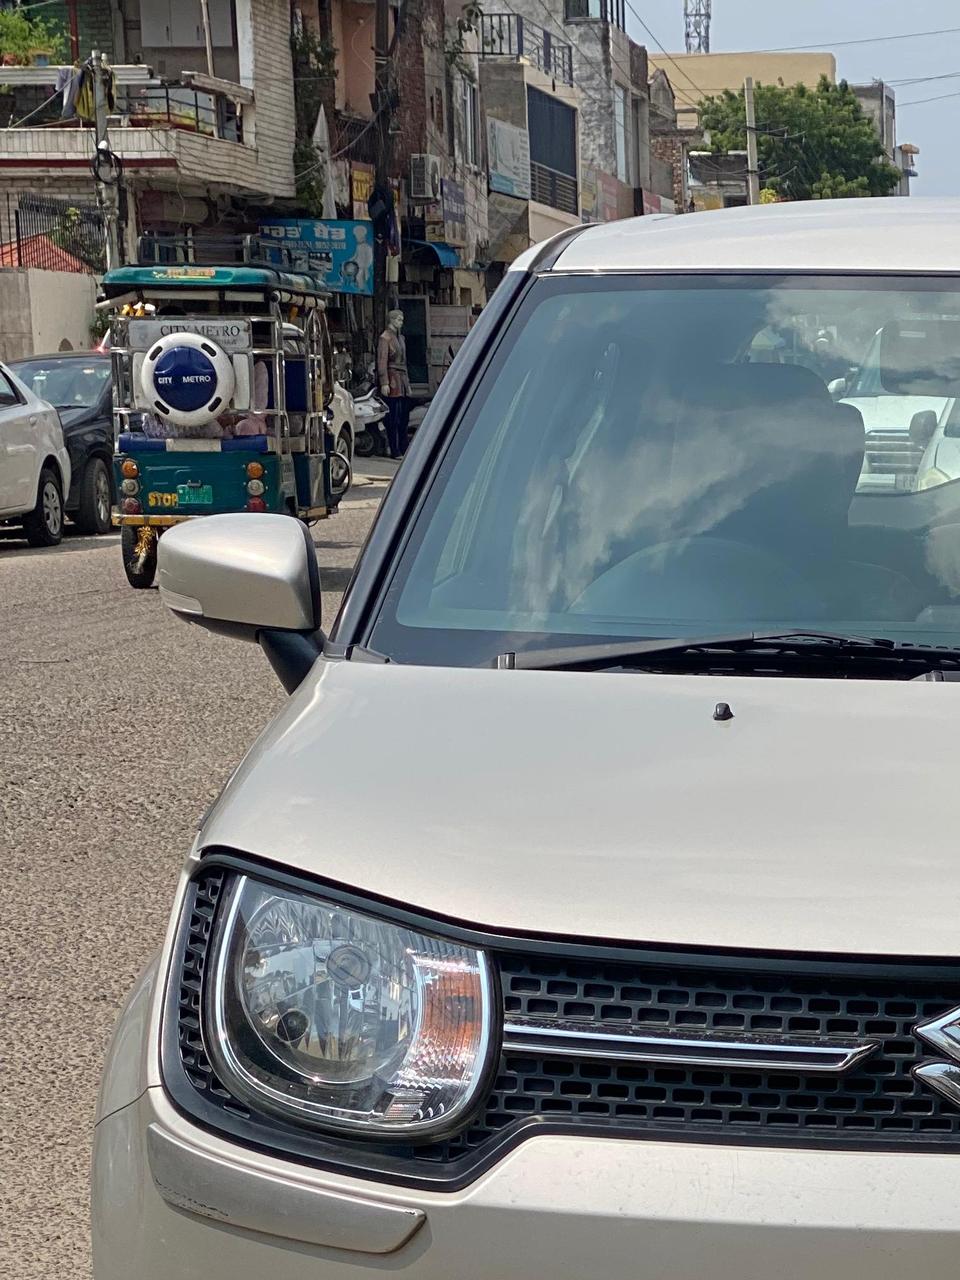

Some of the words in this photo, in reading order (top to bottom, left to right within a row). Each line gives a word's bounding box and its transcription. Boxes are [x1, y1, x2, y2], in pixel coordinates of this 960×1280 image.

[160, 326, 191, 336] CITY
[194, 326, 240, 336] METRO
[158, 376, 172, 384] CITY
[182, 375, 211, 383] METRO
[148, 492, 178, 507] STOP
